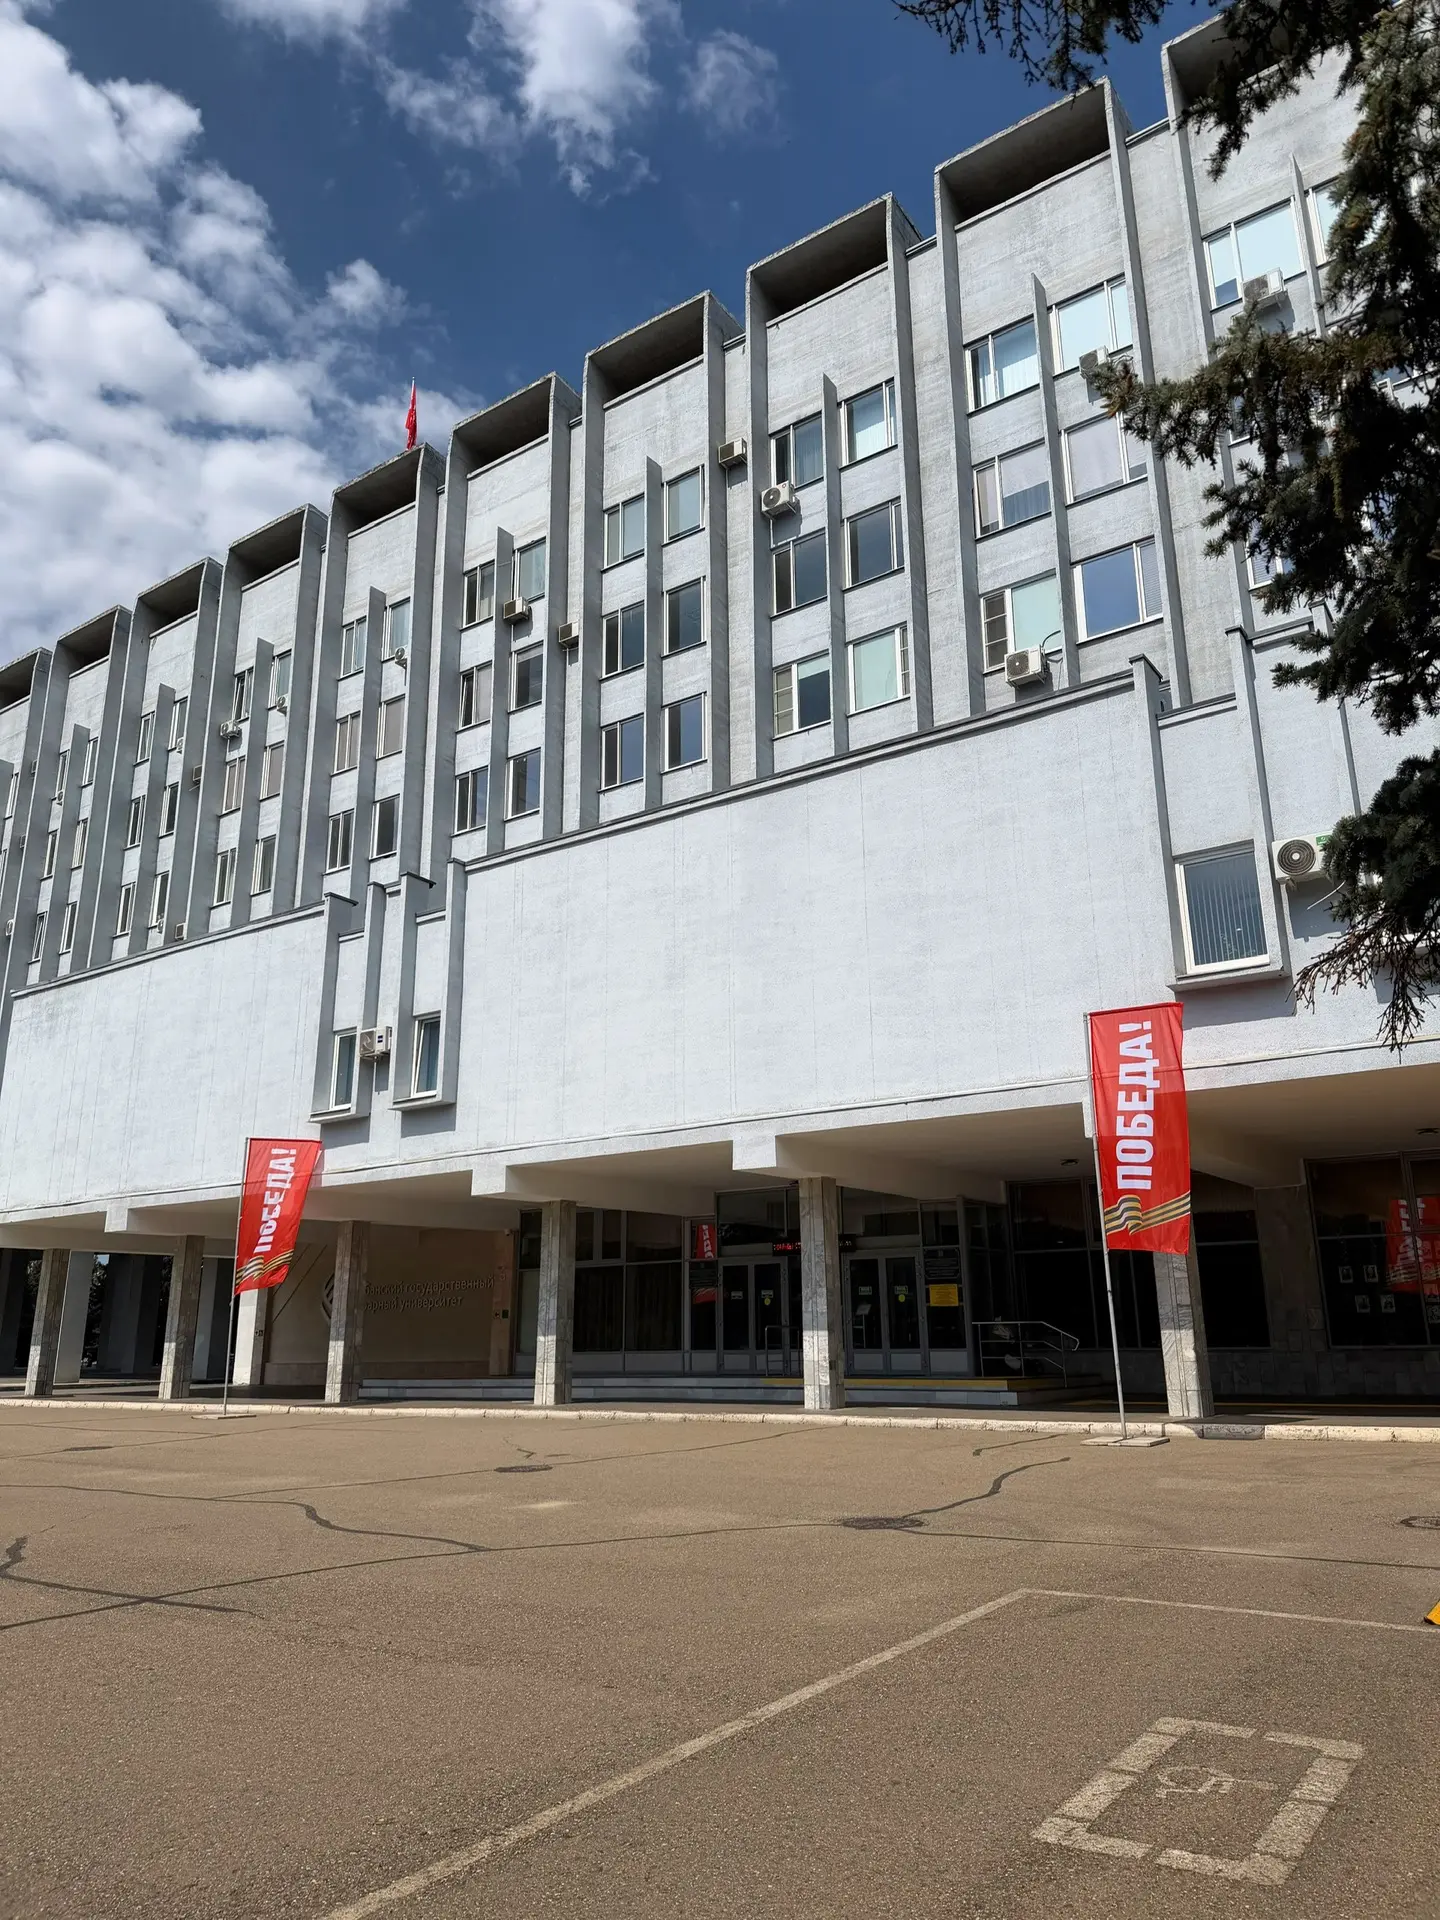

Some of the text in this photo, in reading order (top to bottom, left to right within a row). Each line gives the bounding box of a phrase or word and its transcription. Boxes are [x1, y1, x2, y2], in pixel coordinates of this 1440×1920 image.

[1115, 1020, 1160, 1190] ПОБЕДА!
[253, 1148, 297, 1253] ПОБЕДА!
[364, 1296, 463, 1313] арный университет
[365, 1276, 494, 1297] банский государственный
